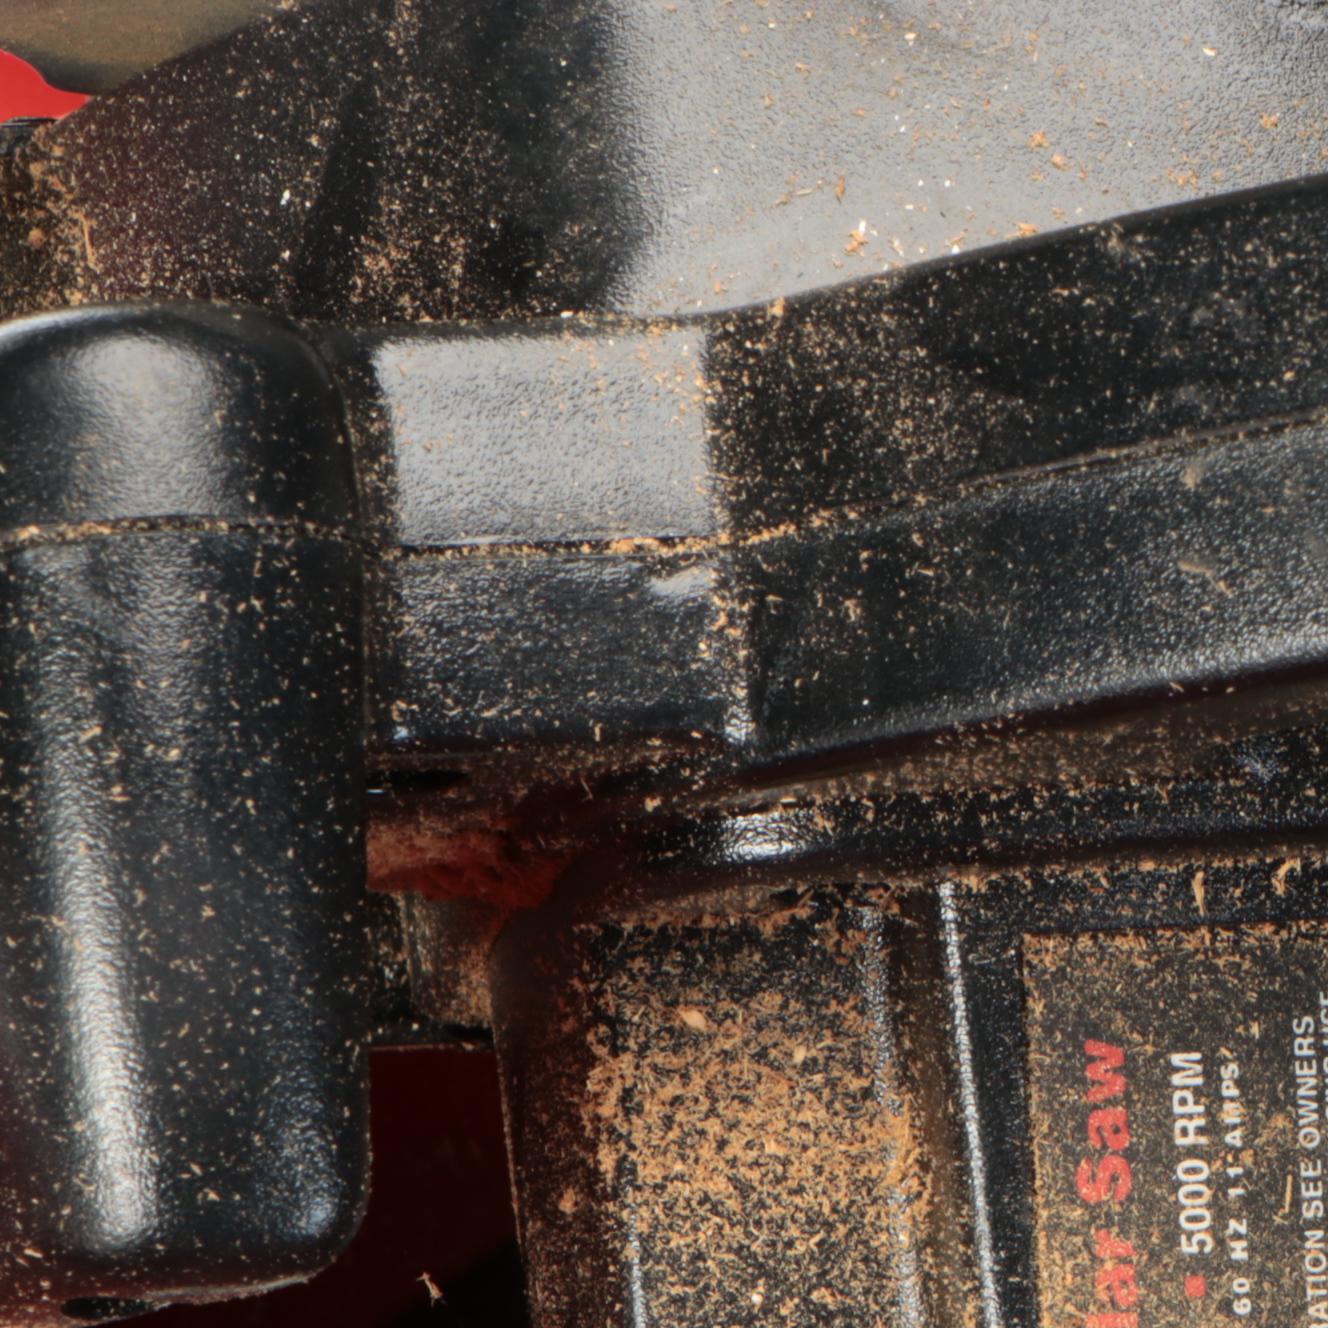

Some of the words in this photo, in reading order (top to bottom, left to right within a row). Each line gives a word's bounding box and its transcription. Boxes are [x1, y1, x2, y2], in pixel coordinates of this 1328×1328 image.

[1075, 1037, 1131, 1204] Saw
[1170, 1051, 1206, 1145] RPM
[1220, 1063, 1242, 1146] AMPS
[1292, 1015, 1320, 1148] OWNERS
[1176, 1158, 1213, 1254] 5000
[1299, 1159, 1324, 1218] SEE
[1228, 1218, 1248, 1260] HZ
[1231, 1277, 1251, 1314] 60
